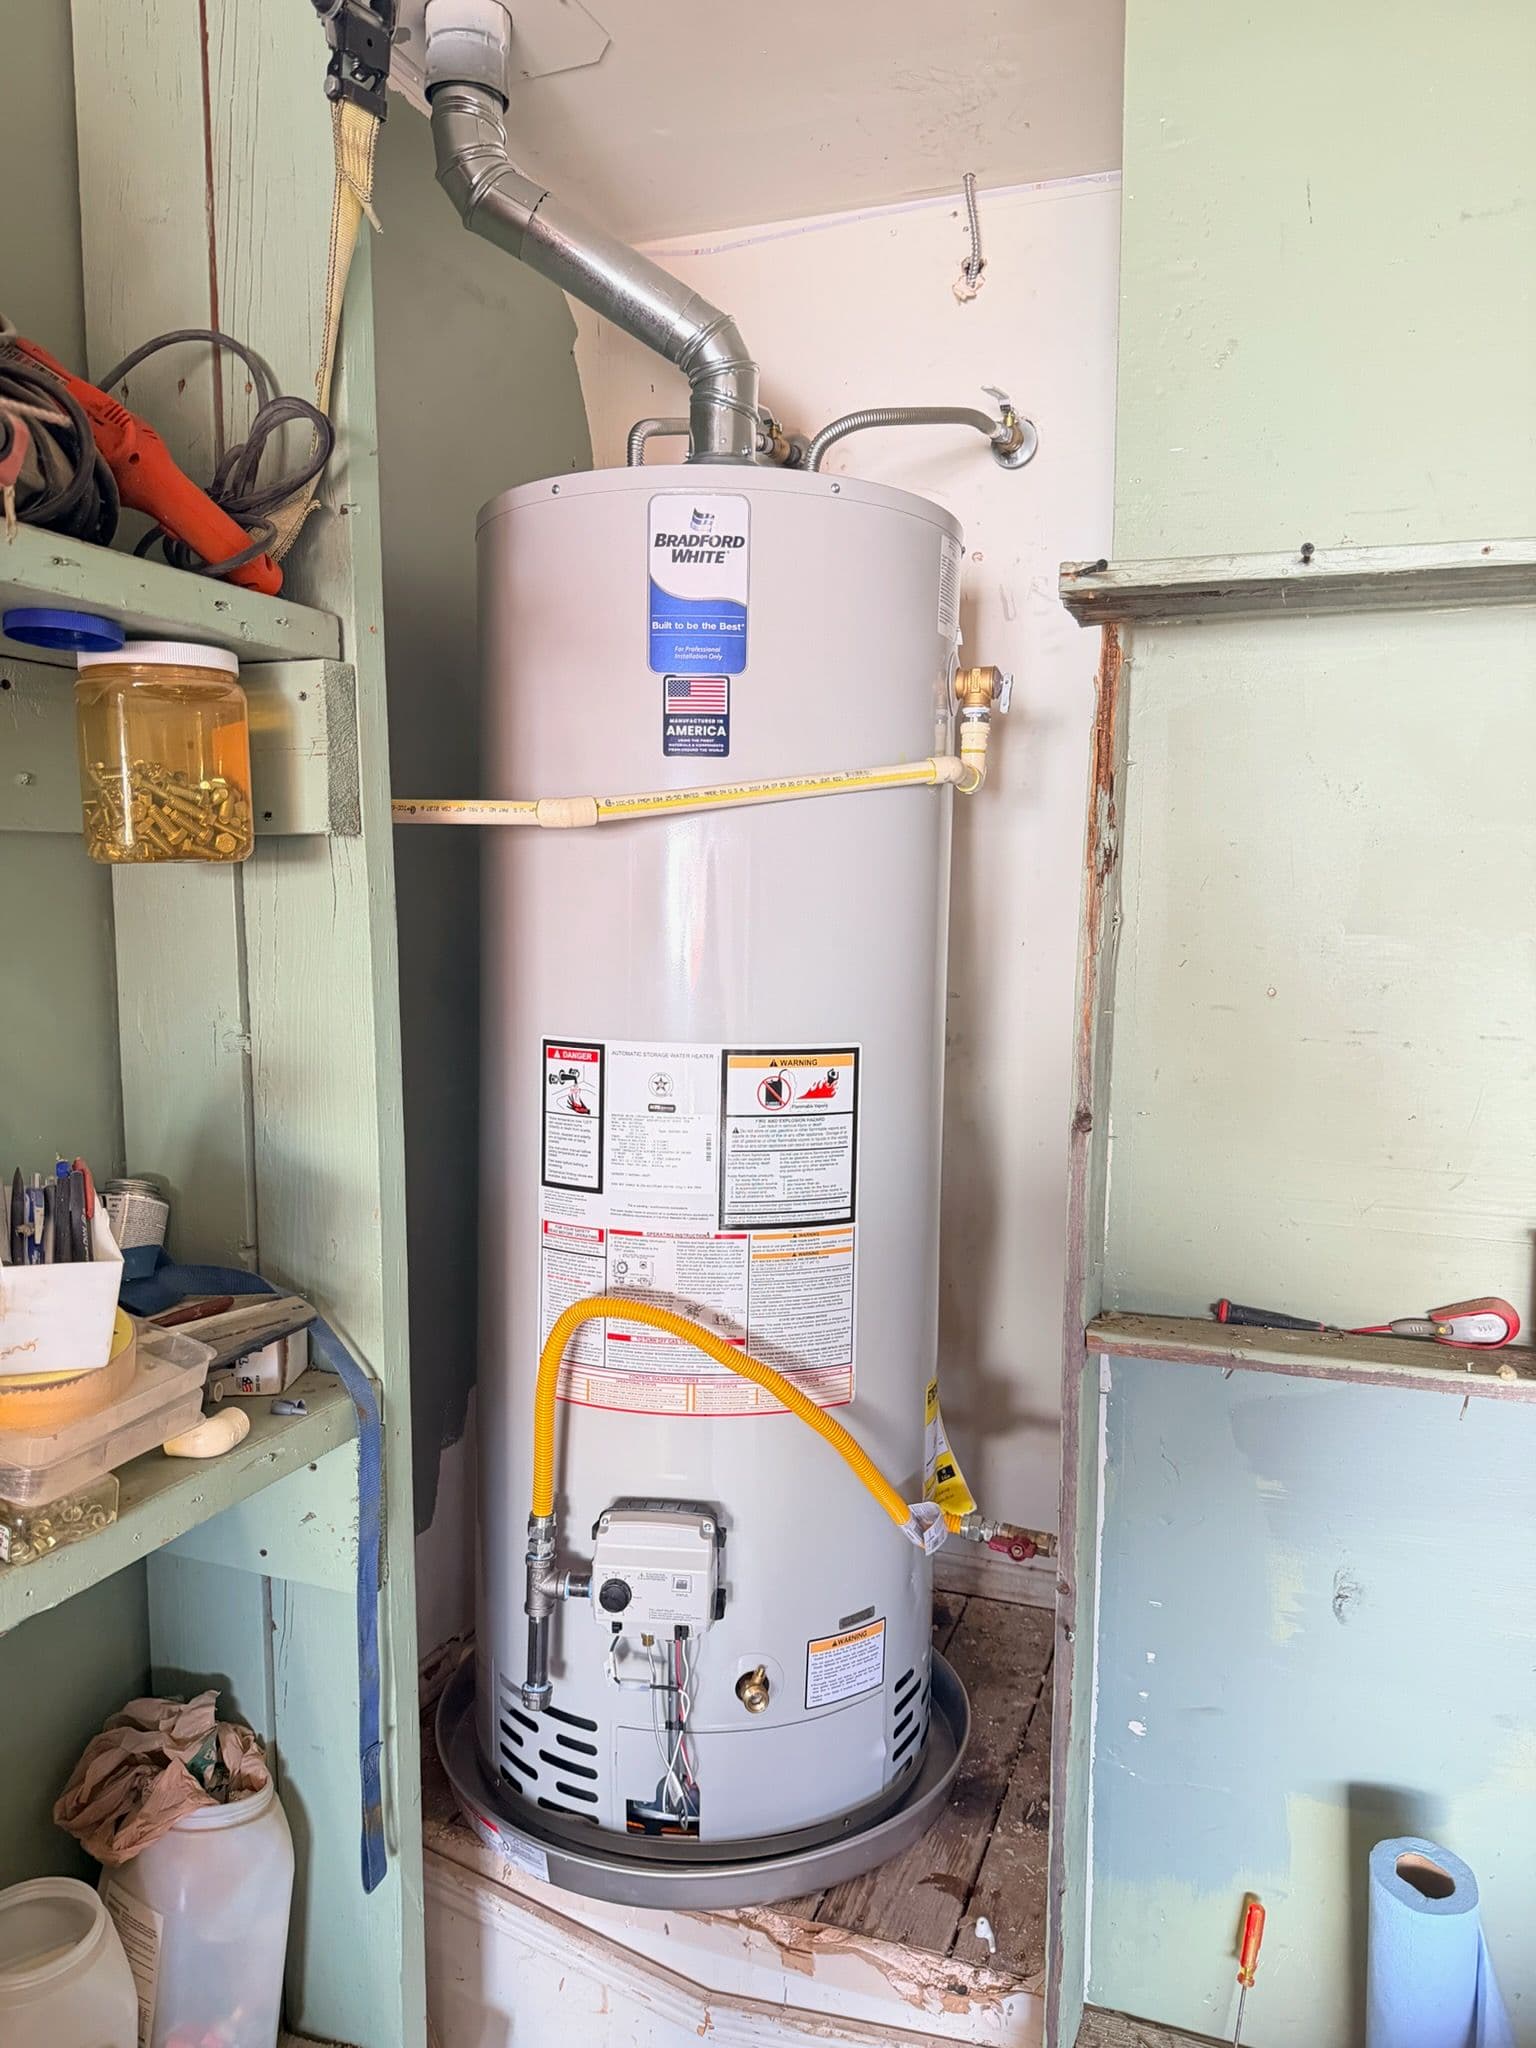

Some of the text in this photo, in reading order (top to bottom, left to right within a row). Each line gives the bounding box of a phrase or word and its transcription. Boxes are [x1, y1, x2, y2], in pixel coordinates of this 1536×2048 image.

[654, 533, 745, 548] BRADFORD
[671, 549, 726, 563] WHITE
[652, 621, 672, 630] Built
[675, 622, 684, 630] to
[686, 622, 698, 630] be
[702, 622, 716, 630] the
[666, 725, 726, 736] AMERICA
[562, 1050, 592, 1060] DANGER
[838, 1630, 867, 1645] WARNING
